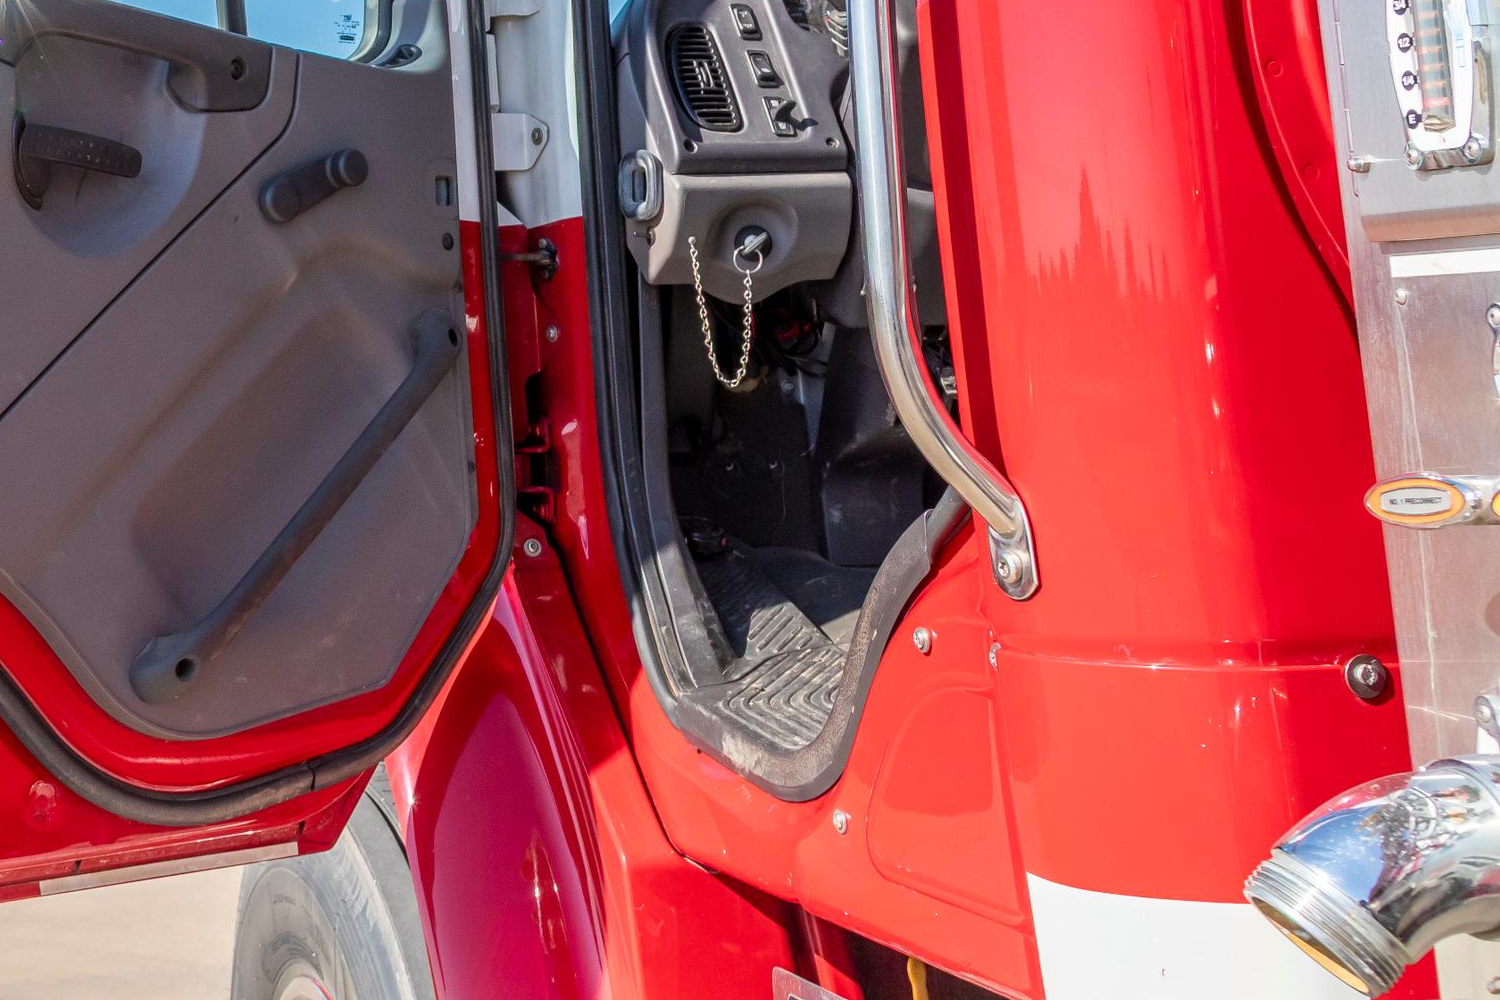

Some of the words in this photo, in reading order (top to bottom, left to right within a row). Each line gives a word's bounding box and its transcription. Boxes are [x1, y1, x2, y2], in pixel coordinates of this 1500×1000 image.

[1393, 0, 1406, 10] 3/4
[1398, 38, 1410, 48] 1/2
[1402, 76, 1414, 86] 1/4
[1408, 114, 1416, 124] E
